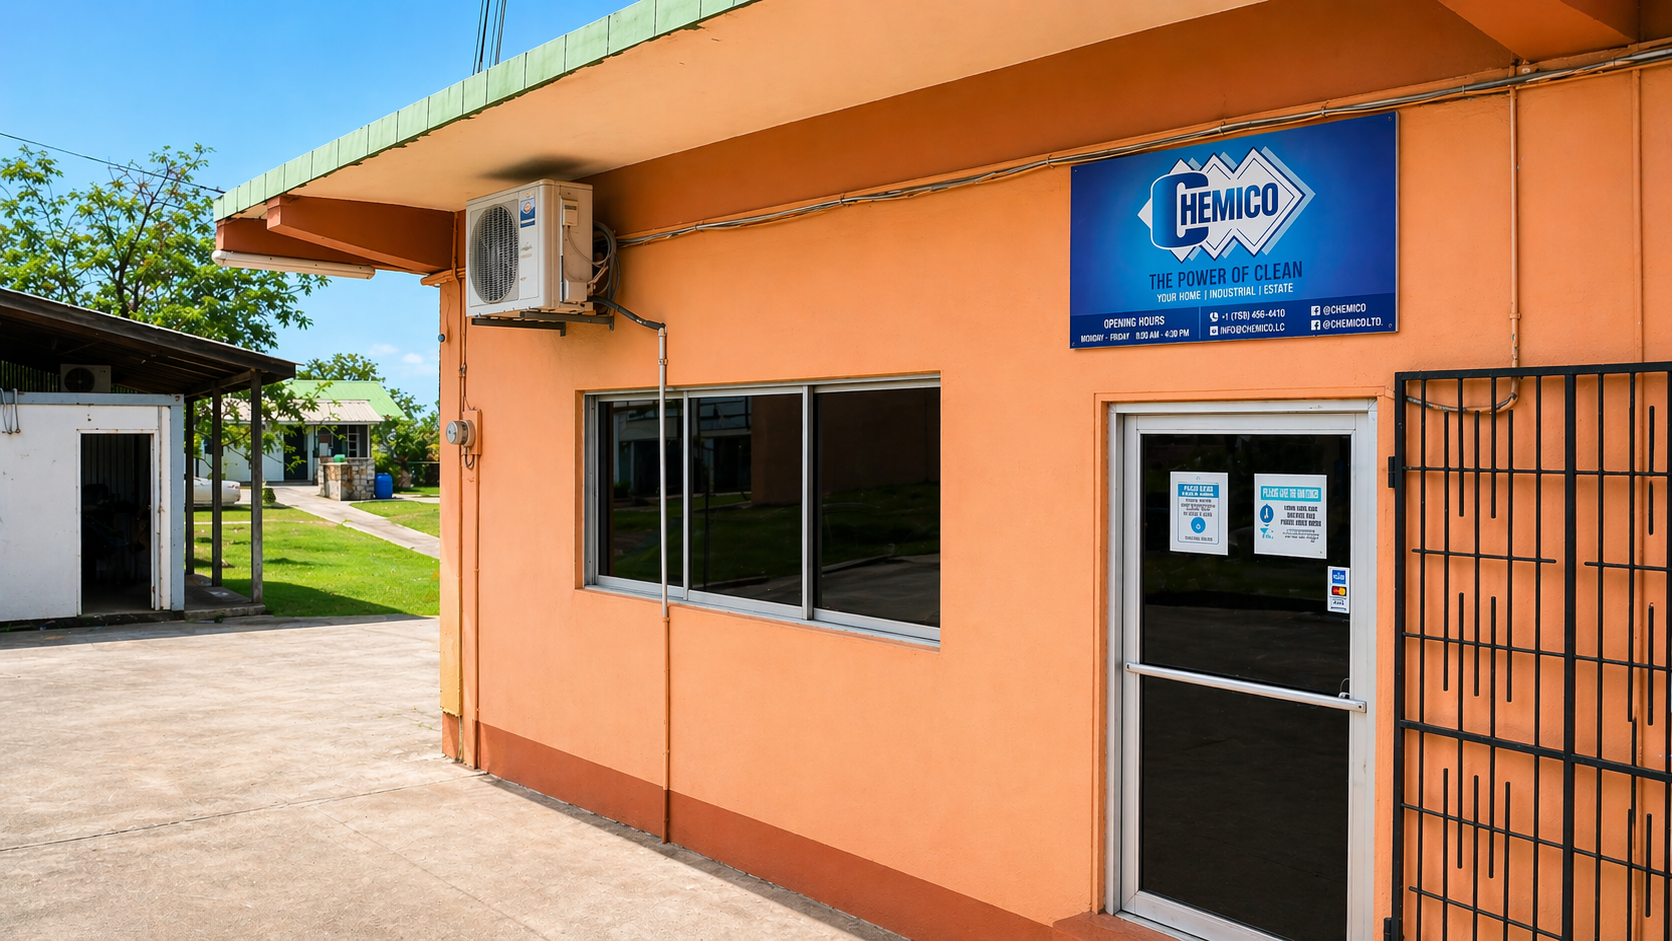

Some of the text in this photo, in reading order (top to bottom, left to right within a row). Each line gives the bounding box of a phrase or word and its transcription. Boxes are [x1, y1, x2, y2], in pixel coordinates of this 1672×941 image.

[1151, 171, 1279, 249] CHEMICO
[1149, 261, 1303, 290] THE POWER OF CLEAN
[1157, 292, 1177, 303] YOUR
[1179, 290, 1201, 301] HOME
[1209, 286, 1256, 299] INDUSTRIAL
[1264, 283, 1294, 294] ESTATE
[1323, 303, 1366, 316] @CHEMICO
[1103, 315, 1165, 329] OPENING HOURS
[1220, 322, 1285, 335] INFO@CHEMICO.LC
[1149, 330, 1159, 339] AM
[1179, 328, 1190, 337] PM
